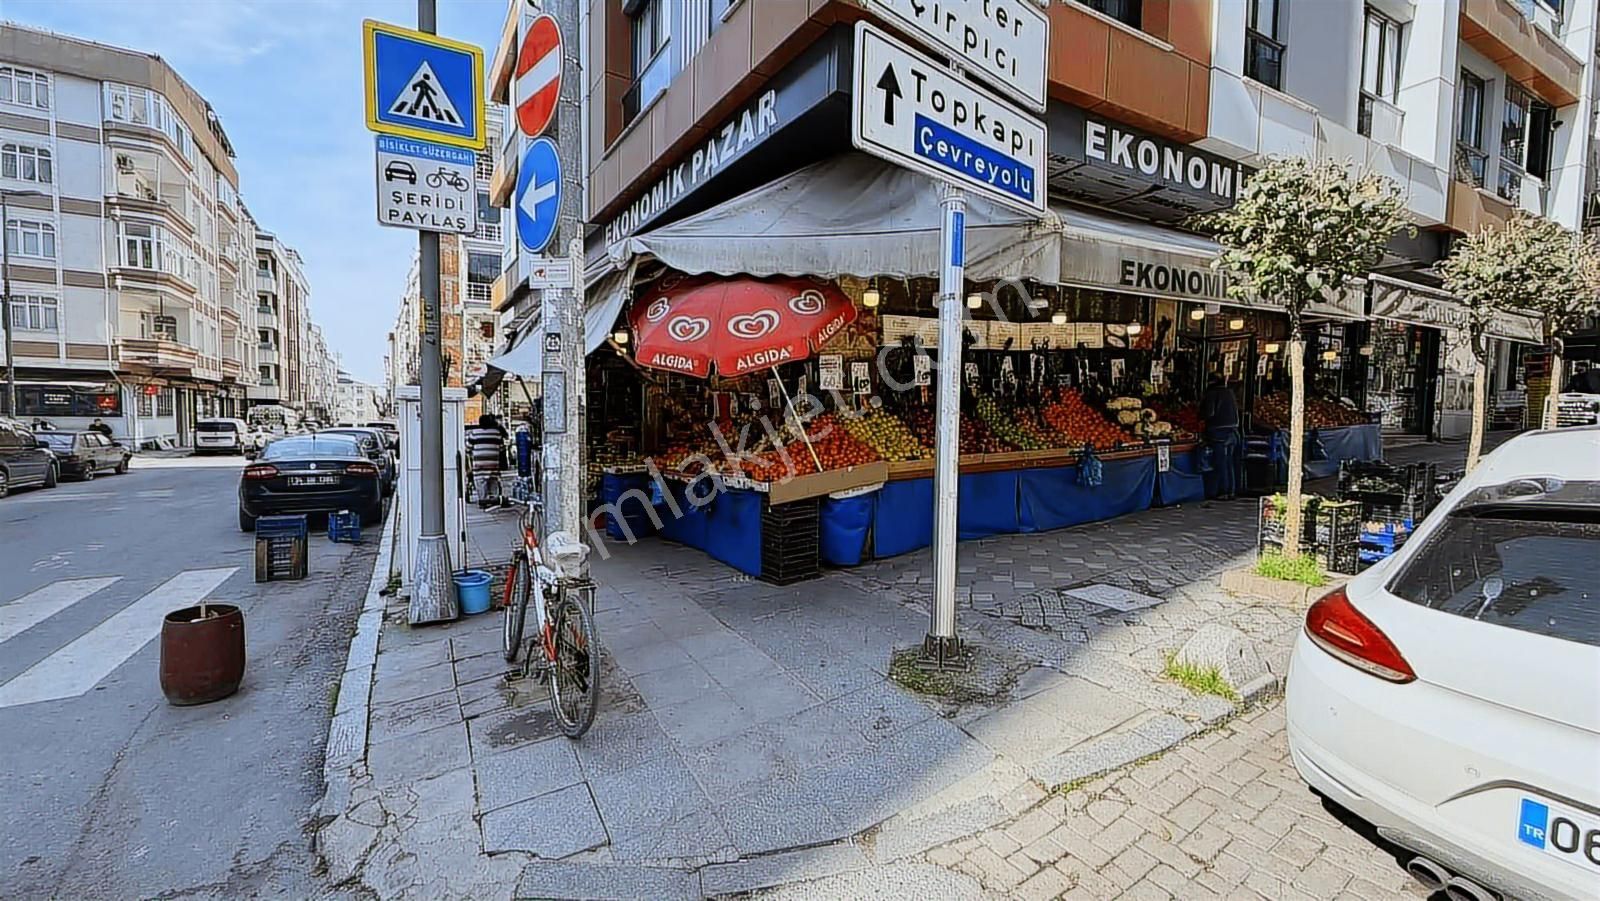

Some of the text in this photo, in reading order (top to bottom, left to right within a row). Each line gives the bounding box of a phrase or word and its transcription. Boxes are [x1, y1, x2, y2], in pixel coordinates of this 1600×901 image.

[984, 0, 1023, 37] ter
[911, 68, 1033, 156] Topkapı
[605, 88, 778, 248] EKONOMİK PAZAR
[920, 126, 1032, 194] Çevreyolu
[1086, 120, 1243, 200] EKONOMİ
[388, 209, 466, 230] PAYLAŞ
[392, 191, 463, 211] ŞERİDİ
[1120, 259, 1228, 298] EKONOMİ
[1523, 823, 1545, 840] TR
[1550, 816, 1600, 867] 06
